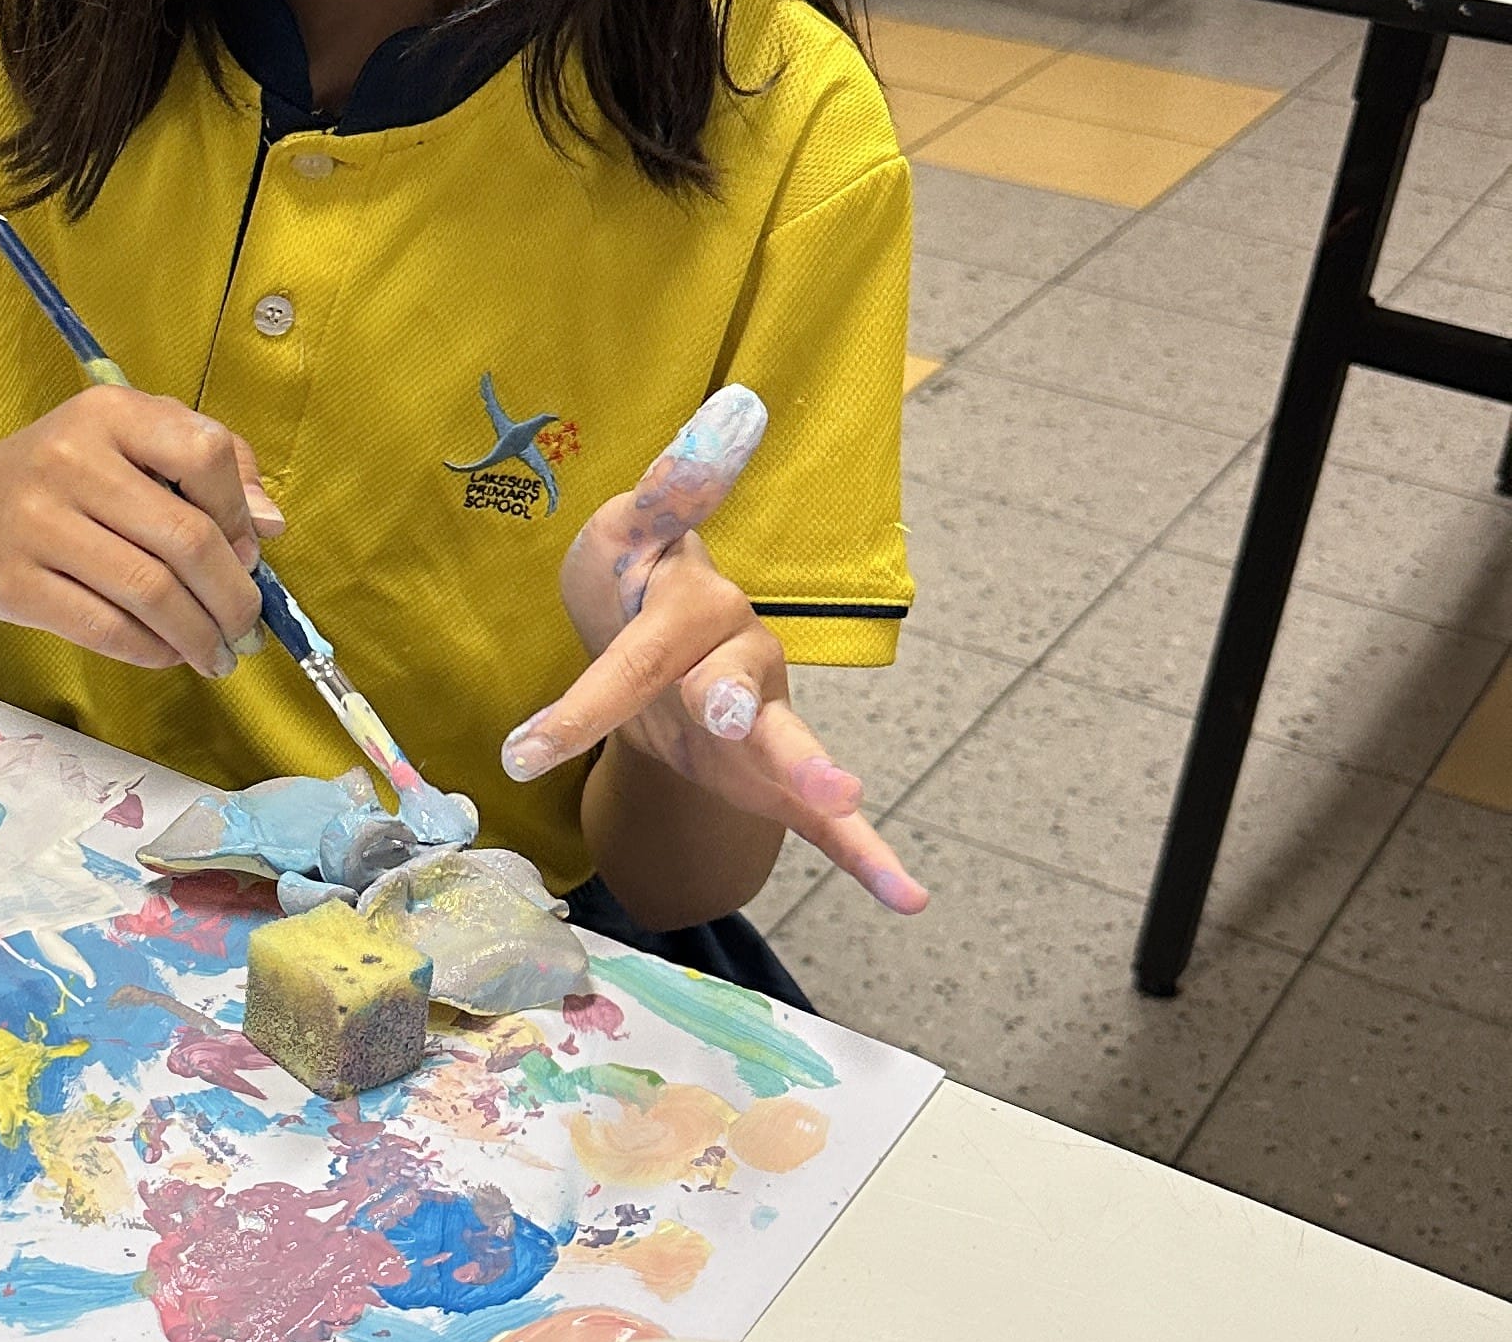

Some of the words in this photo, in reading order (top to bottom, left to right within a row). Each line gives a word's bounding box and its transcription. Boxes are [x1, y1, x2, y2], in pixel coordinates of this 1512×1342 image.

[470, 472, 541, 492] LAKESIDE
[466, 484, 540, 504] PRIMARY
[463, 496, 532, 520] SCHOOL
